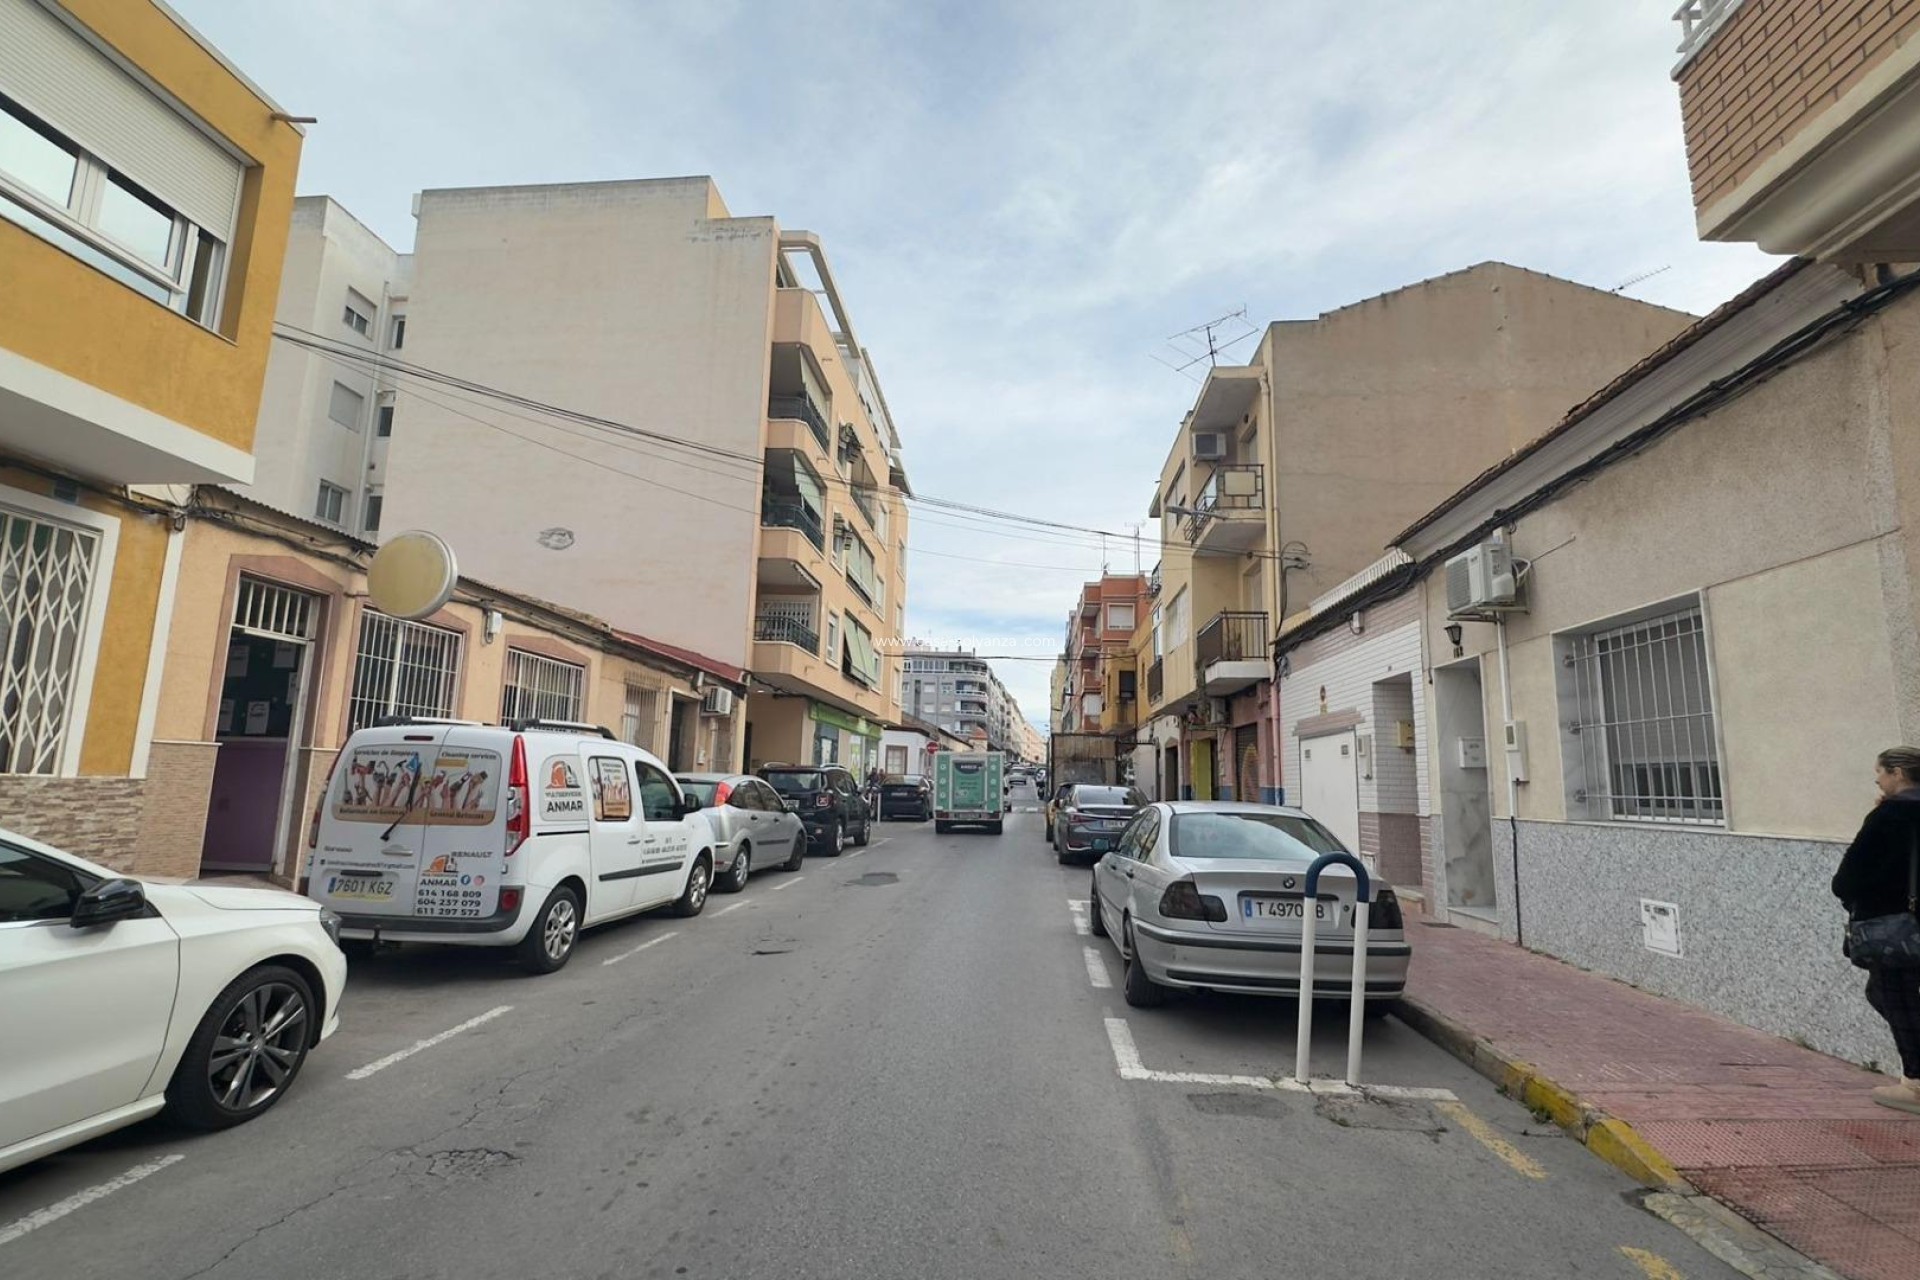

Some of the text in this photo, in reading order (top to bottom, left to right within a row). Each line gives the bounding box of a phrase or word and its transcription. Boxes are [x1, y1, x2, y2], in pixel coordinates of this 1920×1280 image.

[442, 751, 470, 759] Cleaning
[546, 800, 583, 812] ANMAR
[335, 879, 393, 895] 7601 KGZ
[420, 878, 457, 887] ANMAR
[418, 889, 437, 897] 614
[438, 908, 458, 916] 297
[461, 909, 480, 917] 572
[1268, 902, 1304, 917] 4970
